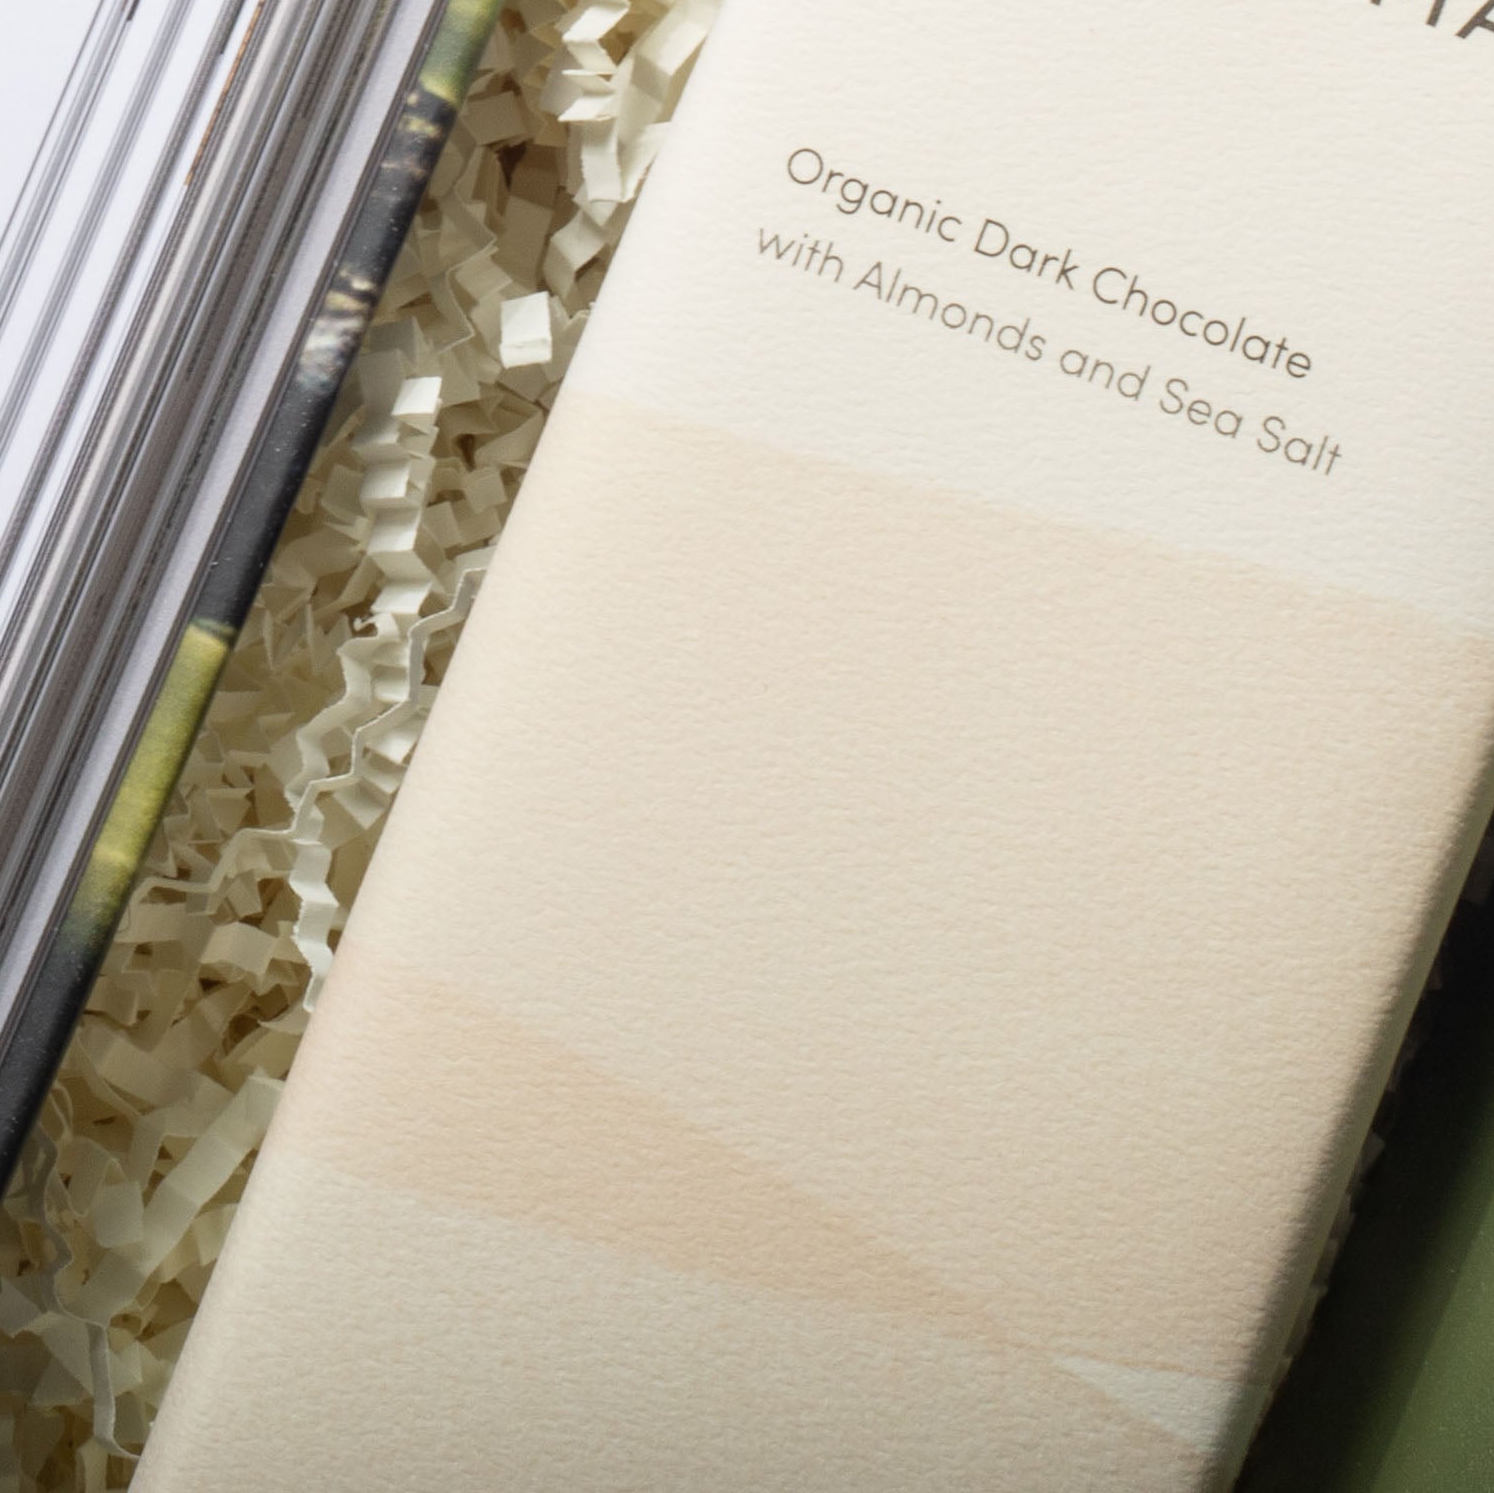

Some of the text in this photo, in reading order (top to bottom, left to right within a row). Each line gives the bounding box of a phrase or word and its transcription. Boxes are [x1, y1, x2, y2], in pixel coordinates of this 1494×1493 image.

[757, 227, 1344, 476] with Almonds and Sea Salt
[786, 147, 1314, 380] Organic Dark Chocolate
